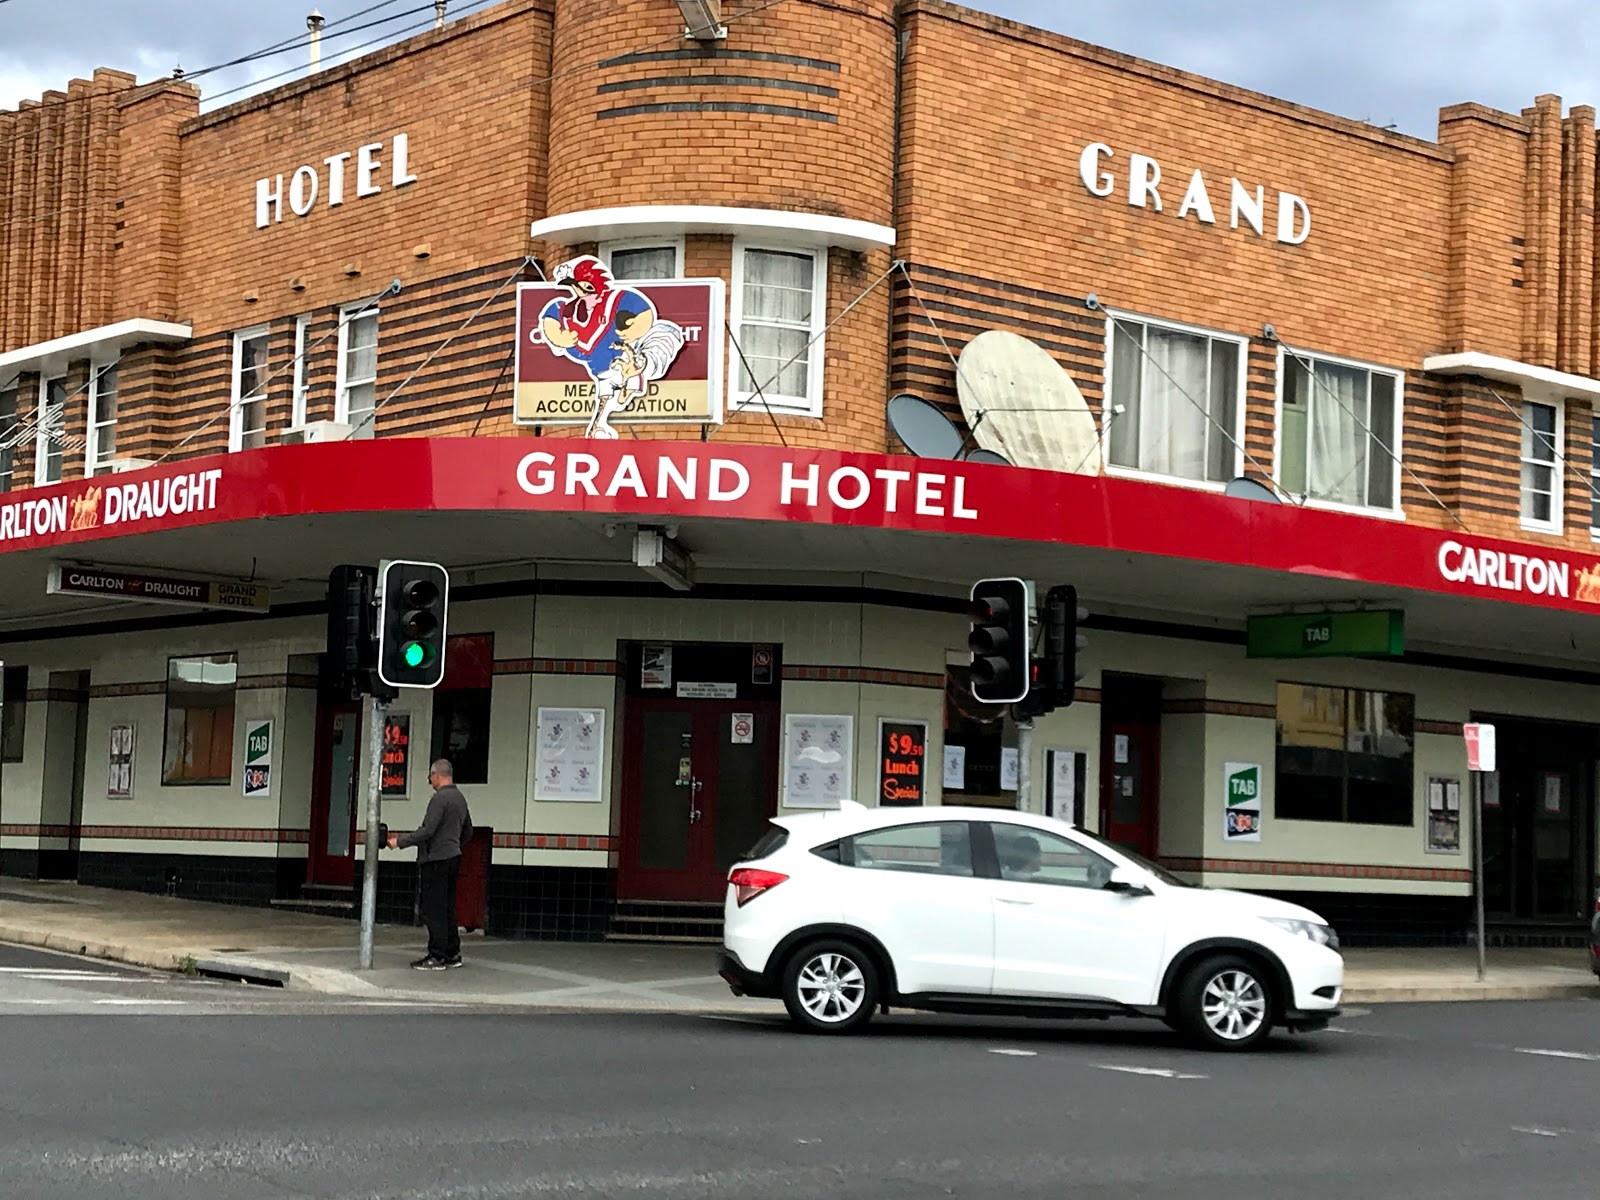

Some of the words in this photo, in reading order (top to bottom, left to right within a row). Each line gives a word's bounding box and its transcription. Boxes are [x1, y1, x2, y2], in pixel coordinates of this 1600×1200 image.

[256, 133, 418, 229] HOTEL
[1079, 142, 1311, 244] GRAND
[564, 384, 596, 397] MEA
[535, 399, 687, 413] ACCOMDATION
[516, 451, 750, 502] GRAND
[781, 462, 979, 520] HOTEL
[0, 496, 67, 540] RLTON
[103, 468, 222, 525] DRAUGHT
[1438, 540, 1569, 598] CARLTON
[69, 573, 124, 590] CARLTON
[144, 581, 201, 597] DRAUGHT
[217, 583, 257, 597] GRAND
[218, 595, 255, 607] HOTEL
[1305, 627, 1330, 642] TAB
[250, 736, 268, 751] TAB
[885, 758, 919, 775] Lunch
[883, 778, 919, 799] Specials
[1231, 778, 1255, 795] TAB
